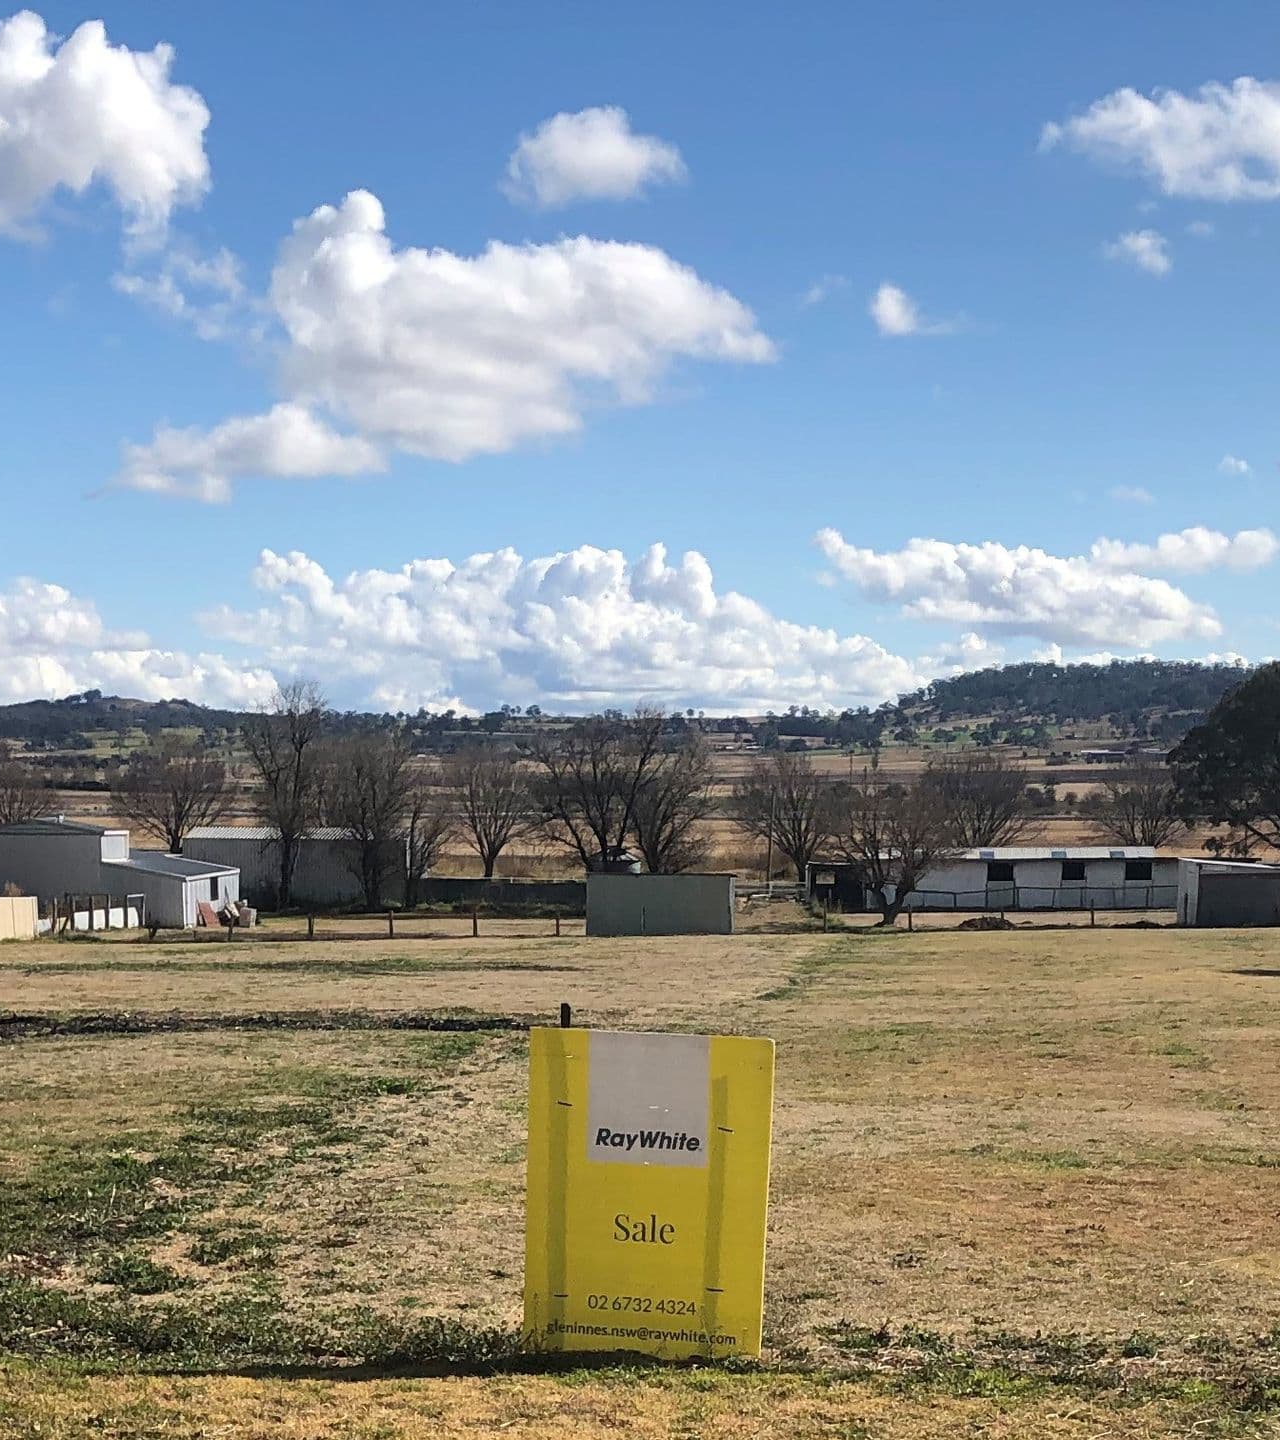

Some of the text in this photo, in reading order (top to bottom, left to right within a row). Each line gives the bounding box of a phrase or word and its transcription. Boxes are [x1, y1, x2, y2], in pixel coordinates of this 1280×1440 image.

[613, 1213, 675, 1245] Sale
[587, 1294, 697, 1315] 02 6732 4324
